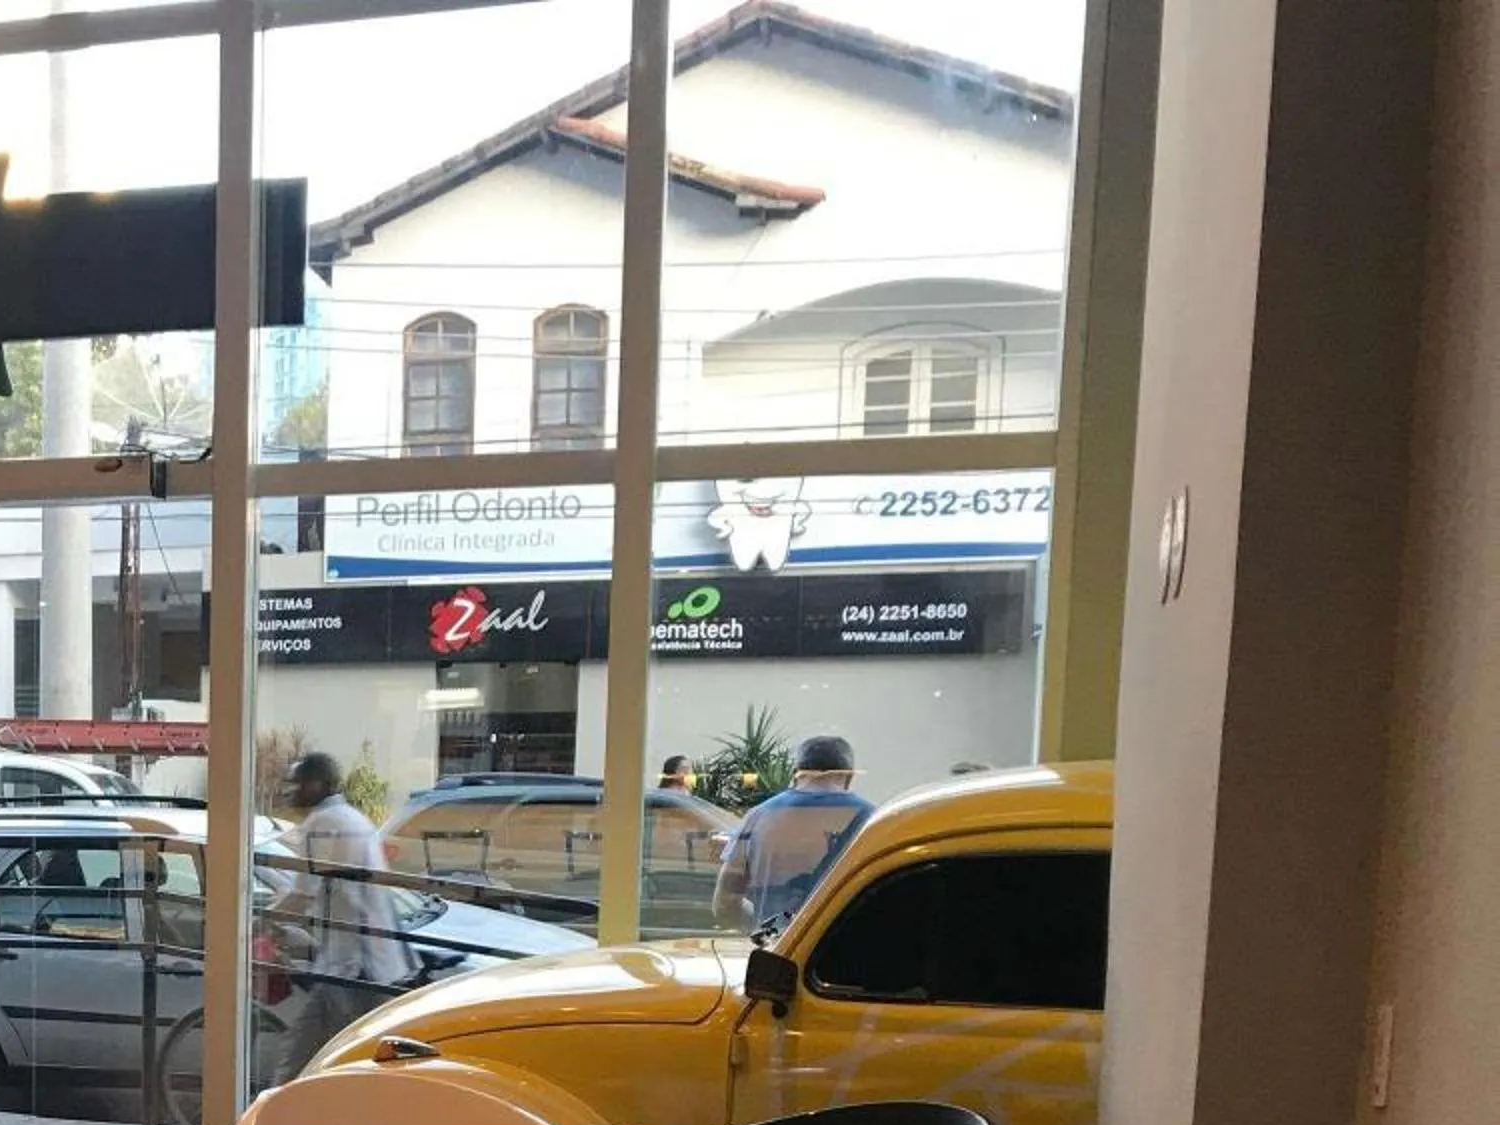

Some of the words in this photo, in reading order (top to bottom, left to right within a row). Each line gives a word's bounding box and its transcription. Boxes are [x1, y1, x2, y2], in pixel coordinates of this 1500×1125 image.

[356, 492, 440, 528] Perfil
[452, 489, 582, 523] Odonto
[879, 485, 1052, 517] 2252-6372
[453, 529, 555, 552] Integrada
[258, 598, 313, 611] STEMAS
[444, 589, 549, 642] Zaal
[842, 604, 875, 625] (24)
[879, 603, 968, 620] 2251-8650
[255, 616, 342, 632] QUIPAMENTOS
[841, 628, 965, 642] www.zaal.com.br
